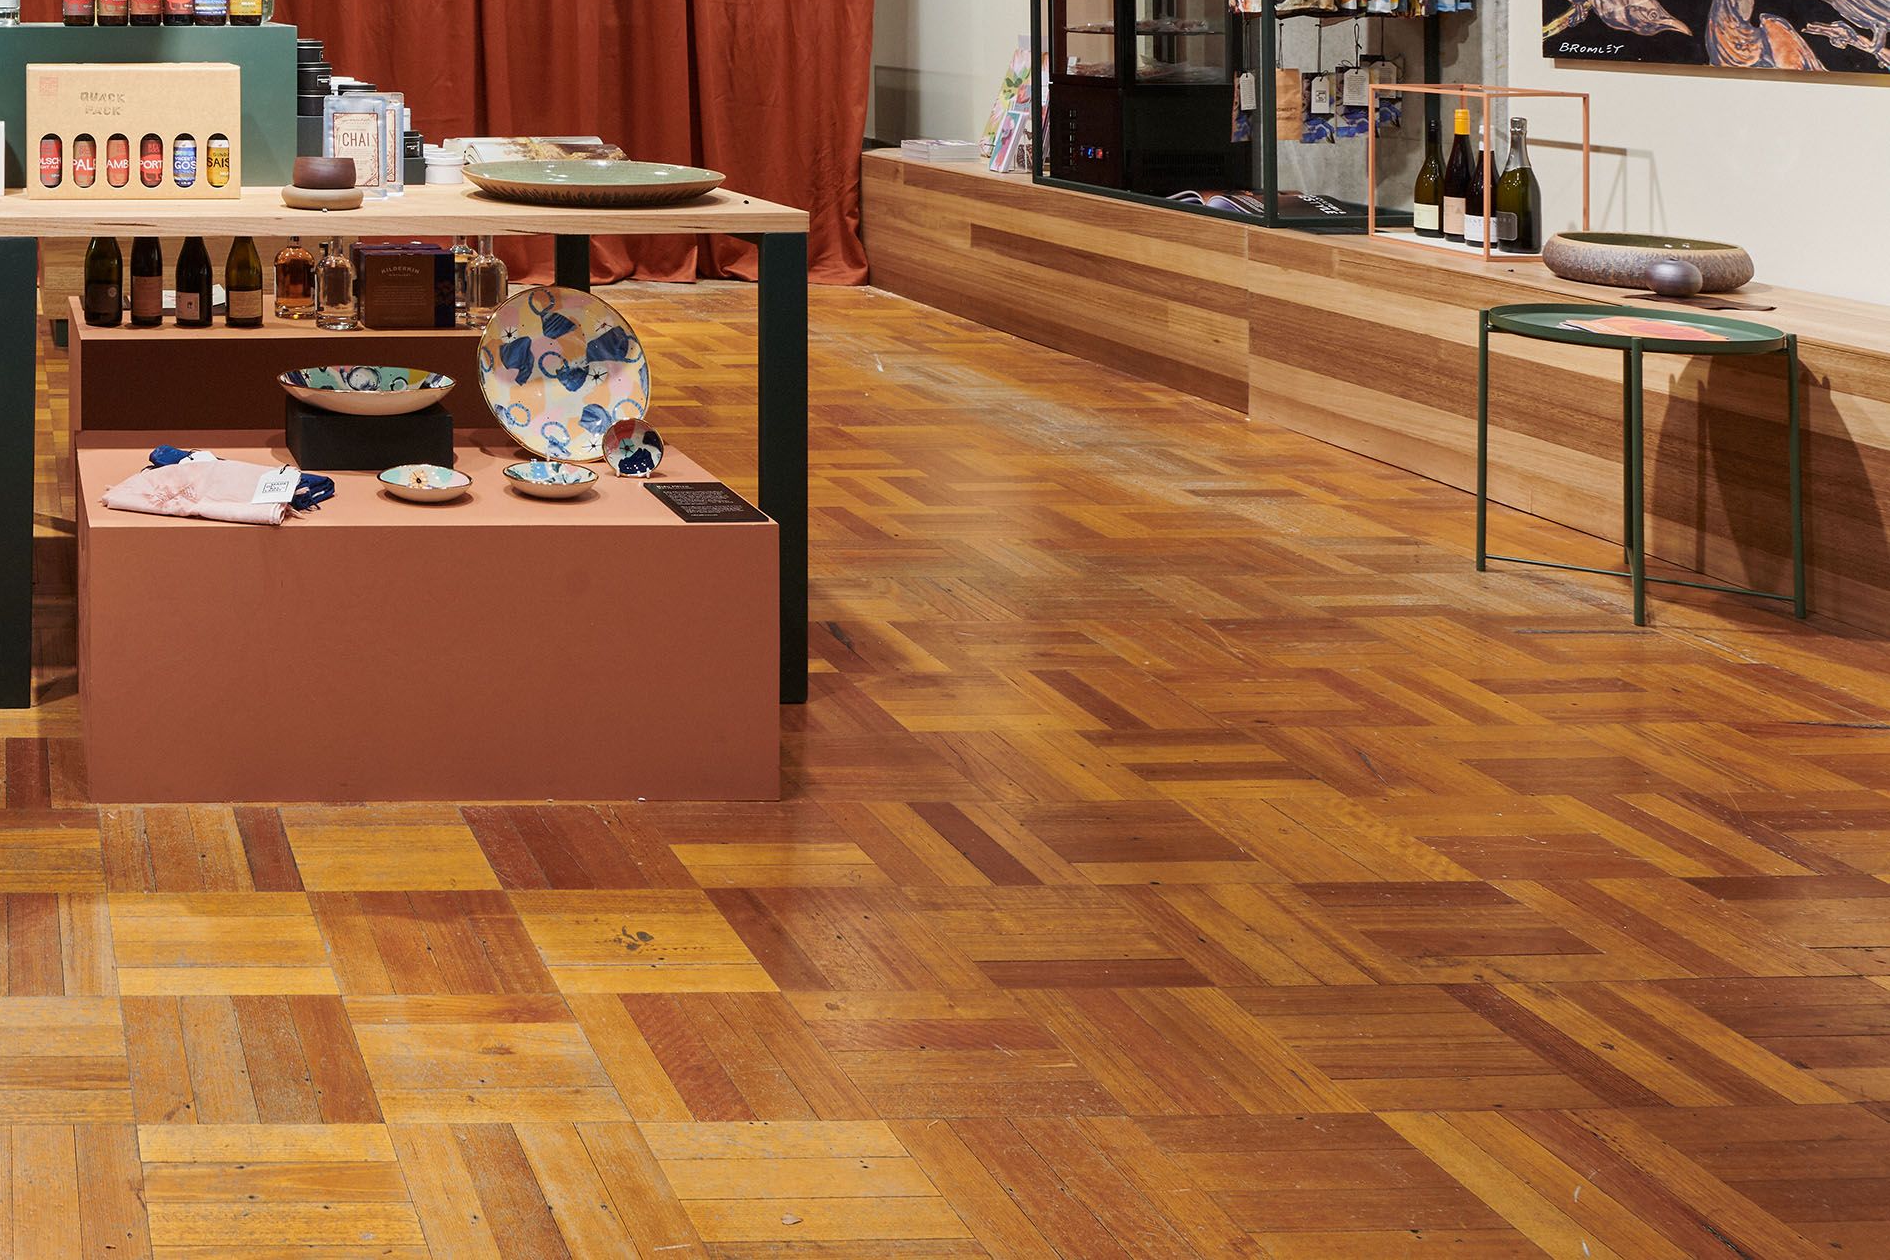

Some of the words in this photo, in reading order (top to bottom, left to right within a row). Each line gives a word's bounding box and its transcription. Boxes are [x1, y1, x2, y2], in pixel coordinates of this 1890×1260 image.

[1558, 42, 1625, 54] BROMLEY
[80, 91, 126, 103] QUACK
[85, 105, 121, 116] PACK
[342, 132, 370, 147] CHAI
